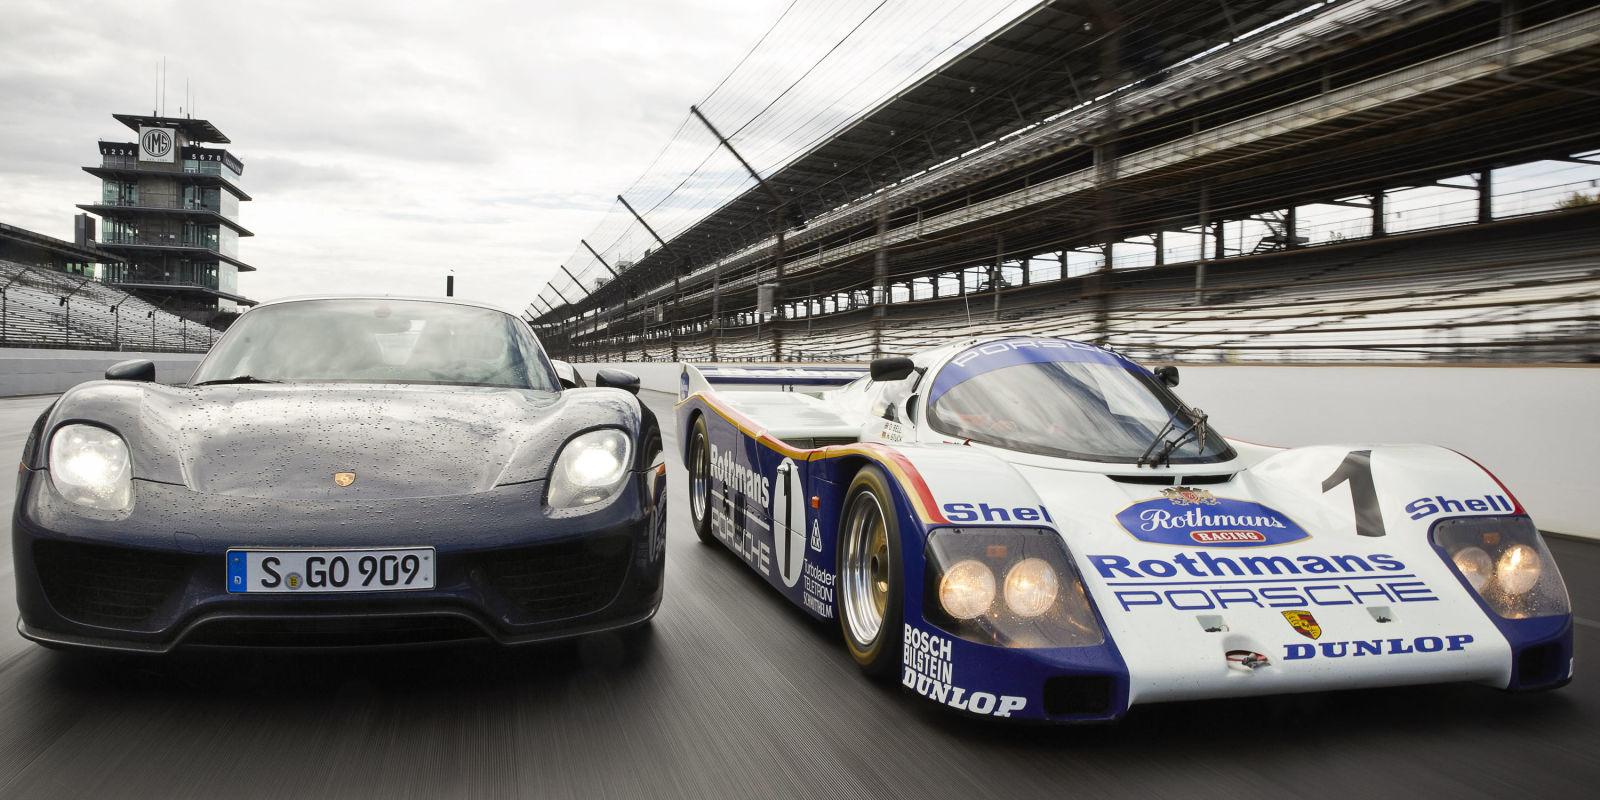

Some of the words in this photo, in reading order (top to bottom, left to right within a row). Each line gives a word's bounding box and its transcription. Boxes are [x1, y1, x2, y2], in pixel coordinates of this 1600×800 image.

[147, 133, 168, 153] IMS
[952, 337, 1129, 367] PORSCH
[710, 443, 770, 509] Rothmans
[1322, 450, 1387, 537] 1
[1405, 495, 1513, 521] Shell
[782, 462, 792, 581] 1
[943, 502, 1053, 524] Shel
[1139, 507, 1287, 532] Rothmans
[1199, 531, 1258, 542] RACING
[261, 556, 282, 589] S
[306, 556, 350, 588] GO
[358, 554, 420, 587] 909
[803, 558, 837, 586] Turbolader
[1086, 551, 1406, 579] Rothmans
[1114, 581, 1440, 612] PORSCHE
[904, 623, 952, 661] BOSCH
[1283, 634, 1475, 660] DUNLOP
[903, 643, 953, 685] BILSTEIN
[902, 665, 1027, 718] DUNLOP
